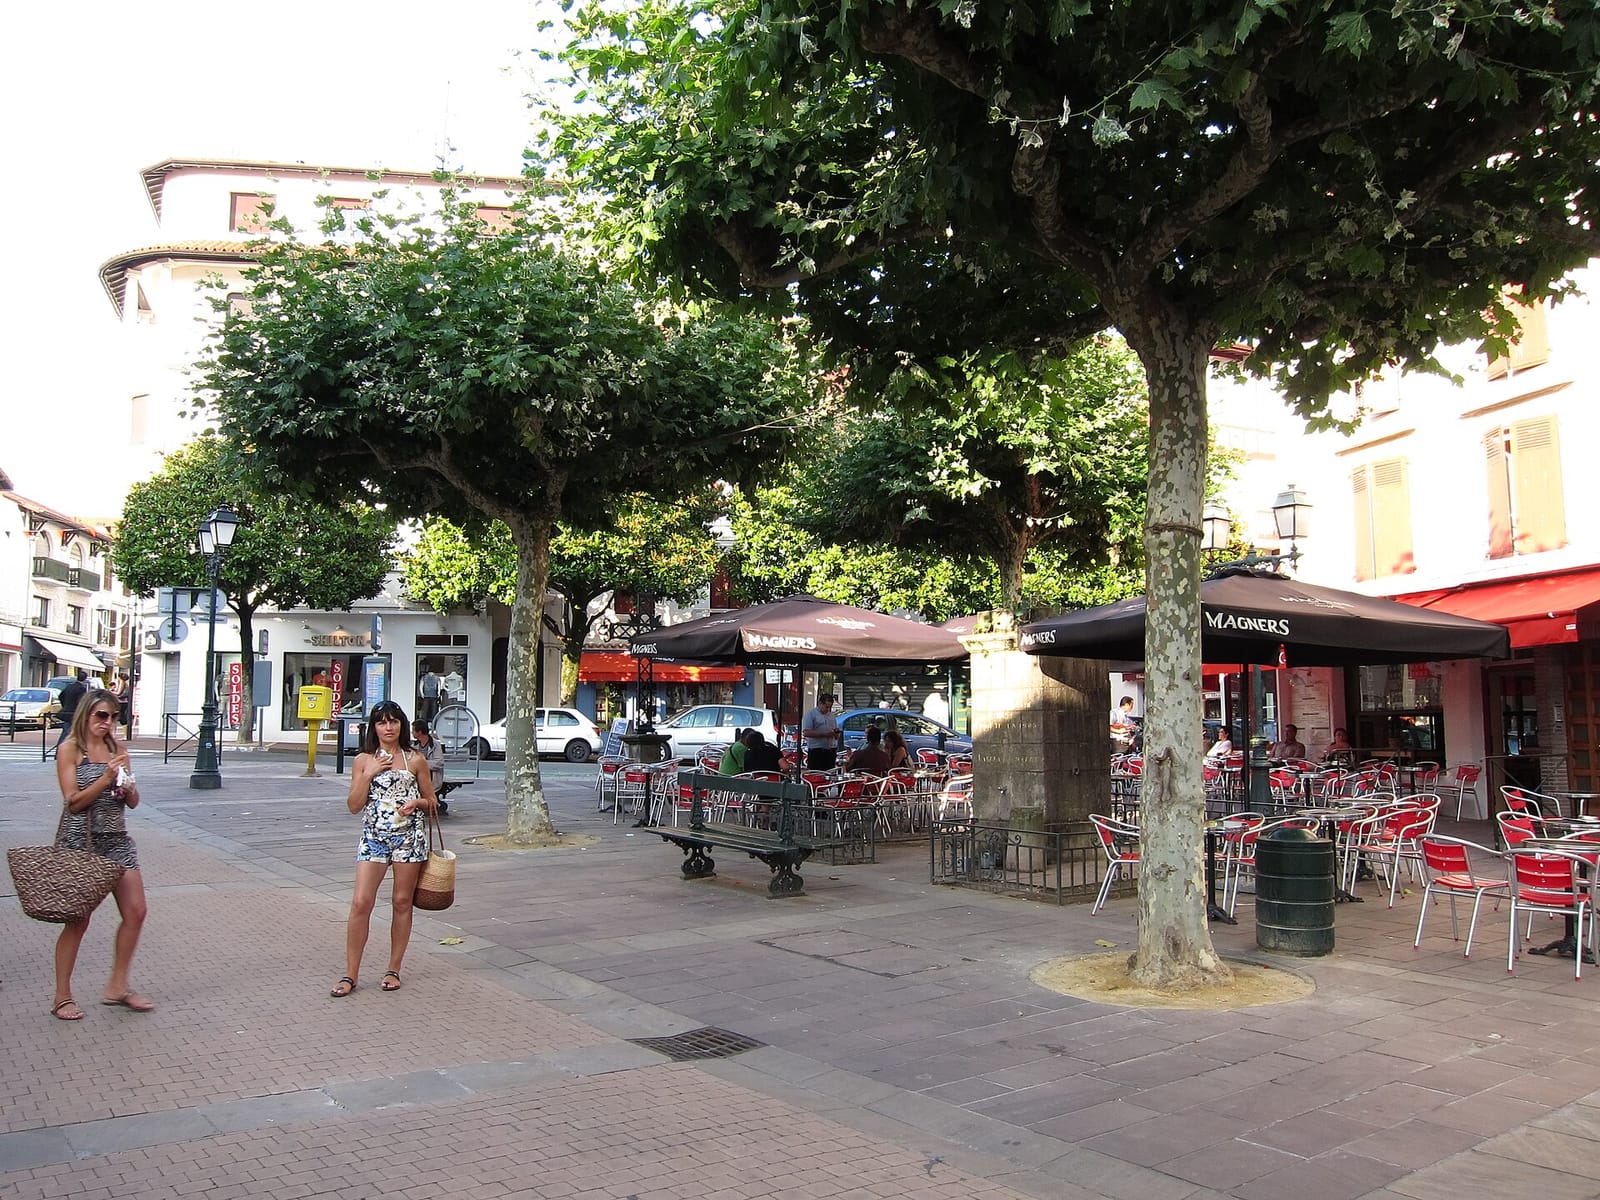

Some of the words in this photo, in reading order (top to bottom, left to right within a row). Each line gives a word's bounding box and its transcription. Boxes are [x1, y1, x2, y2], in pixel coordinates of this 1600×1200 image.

[747, 633, 817, 650] MAGNERS
[1205, 611, 1290, 636] MAGNERS
[231, 664, 241, 725] SOLDES
[331, 663, 342, 722] SOLDES
